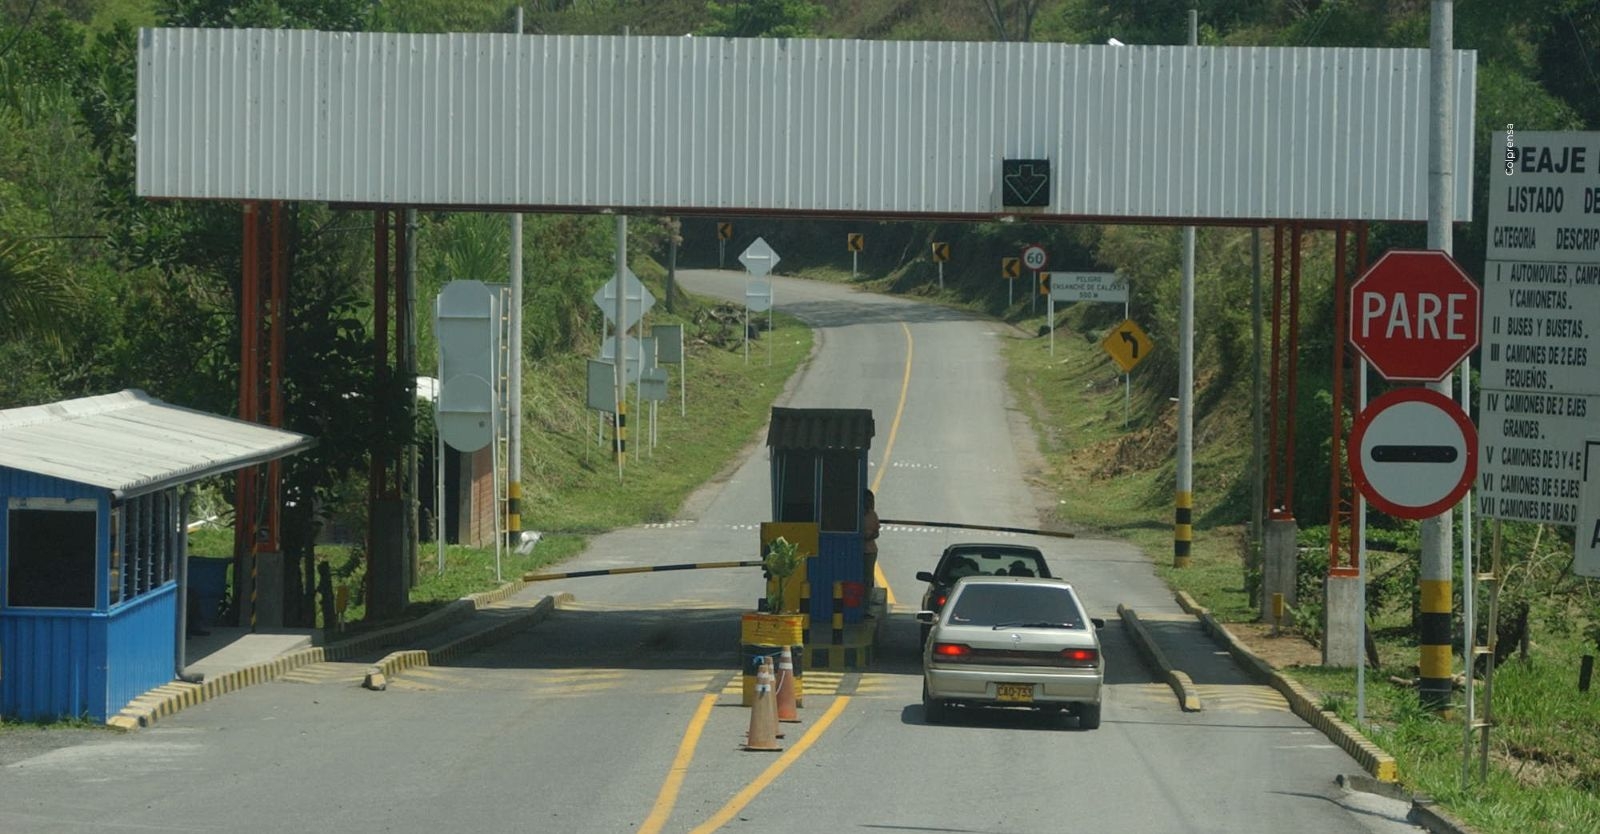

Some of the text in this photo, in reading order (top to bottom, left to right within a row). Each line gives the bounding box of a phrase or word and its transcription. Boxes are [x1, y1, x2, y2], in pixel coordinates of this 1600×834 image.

[1505, 146, 1586, 173] PEAJE
[1507, 186, 1564, 213] LISTADO
[1494, 226, 1600, 250] CATEGORIA DESCRIP
[1027, 252, 1043, 264] 60
[1509, 289, 1515, 306] Y
[1362, 291, 1467, 340] PARE
[1493, 316, 1500, 334] II
[1508, 316, 1533, 336] BUSES
[1537, 318, 1543, 336] Y
[1491, 343, 1587, 367] III CAMIONES DE 2 EJES
[1487, 393, 1586, 417] IV CAMIONES DE 2 EJES
[1486, 446, 1494, 464] V
[1501, 447, 1541, 468] CAMIONES
[1542, 449, 1553, 469] DE
[1554, 450, 1560, 469] 3
[1562, 450, 1568, 470] Y
[1569, 451, 1574, 470] 4
[1483, 473, 1580, 498] VI CAMIONES DE 5 EJES
[1480, 497, 1495, 515] VII
[1500, 498, 1539, 519] CAMIONES
[1541, 501, 1552, 520] DE
[1553, 502, 1569, 522] MAS
